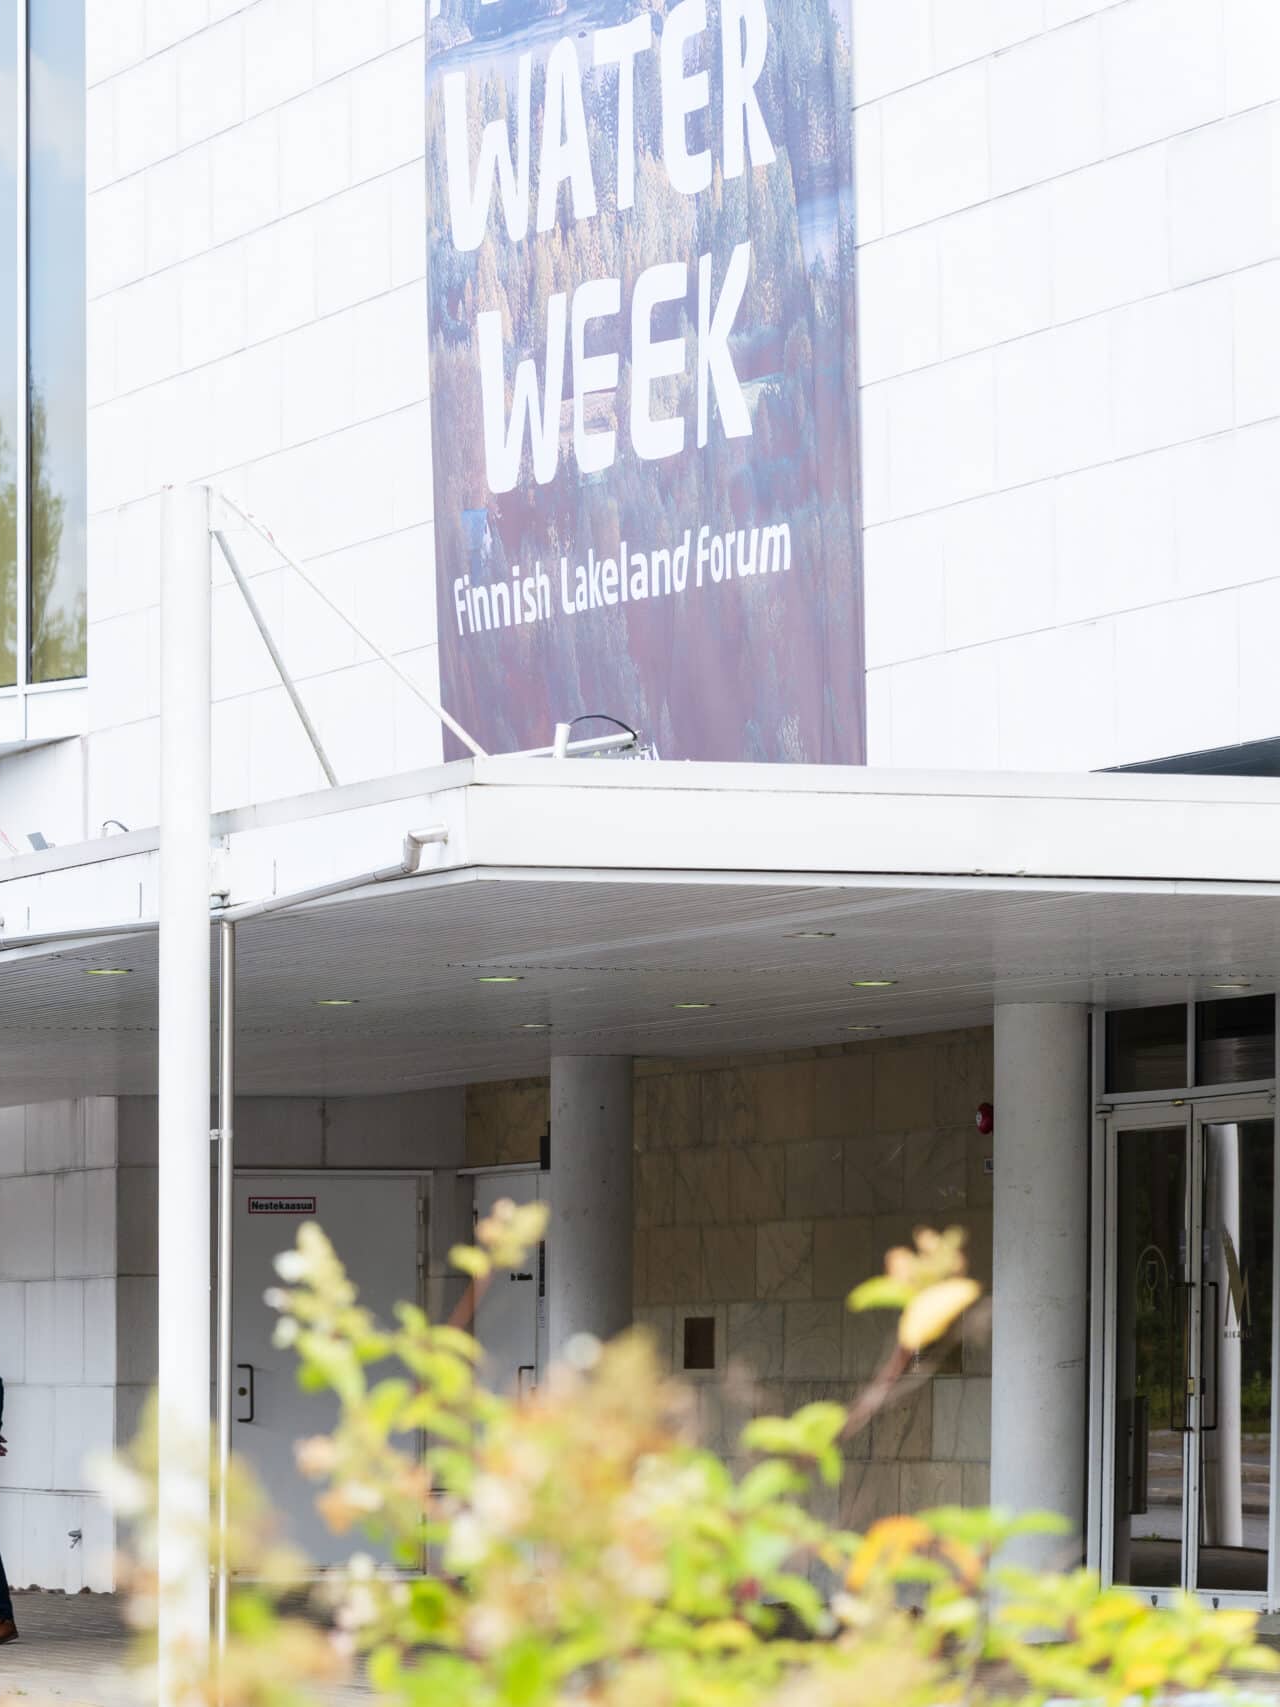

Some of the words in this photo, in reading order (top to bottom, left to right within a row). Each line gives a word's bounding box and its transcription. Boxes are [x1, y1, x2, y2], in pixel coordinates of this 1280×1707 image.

[444, 0, 776, 251] WATER
[476, 241, 754, 494] WEEK
[454, 561, 551, 635] Finnish
[561, 529, 691, 614] Lakeland
